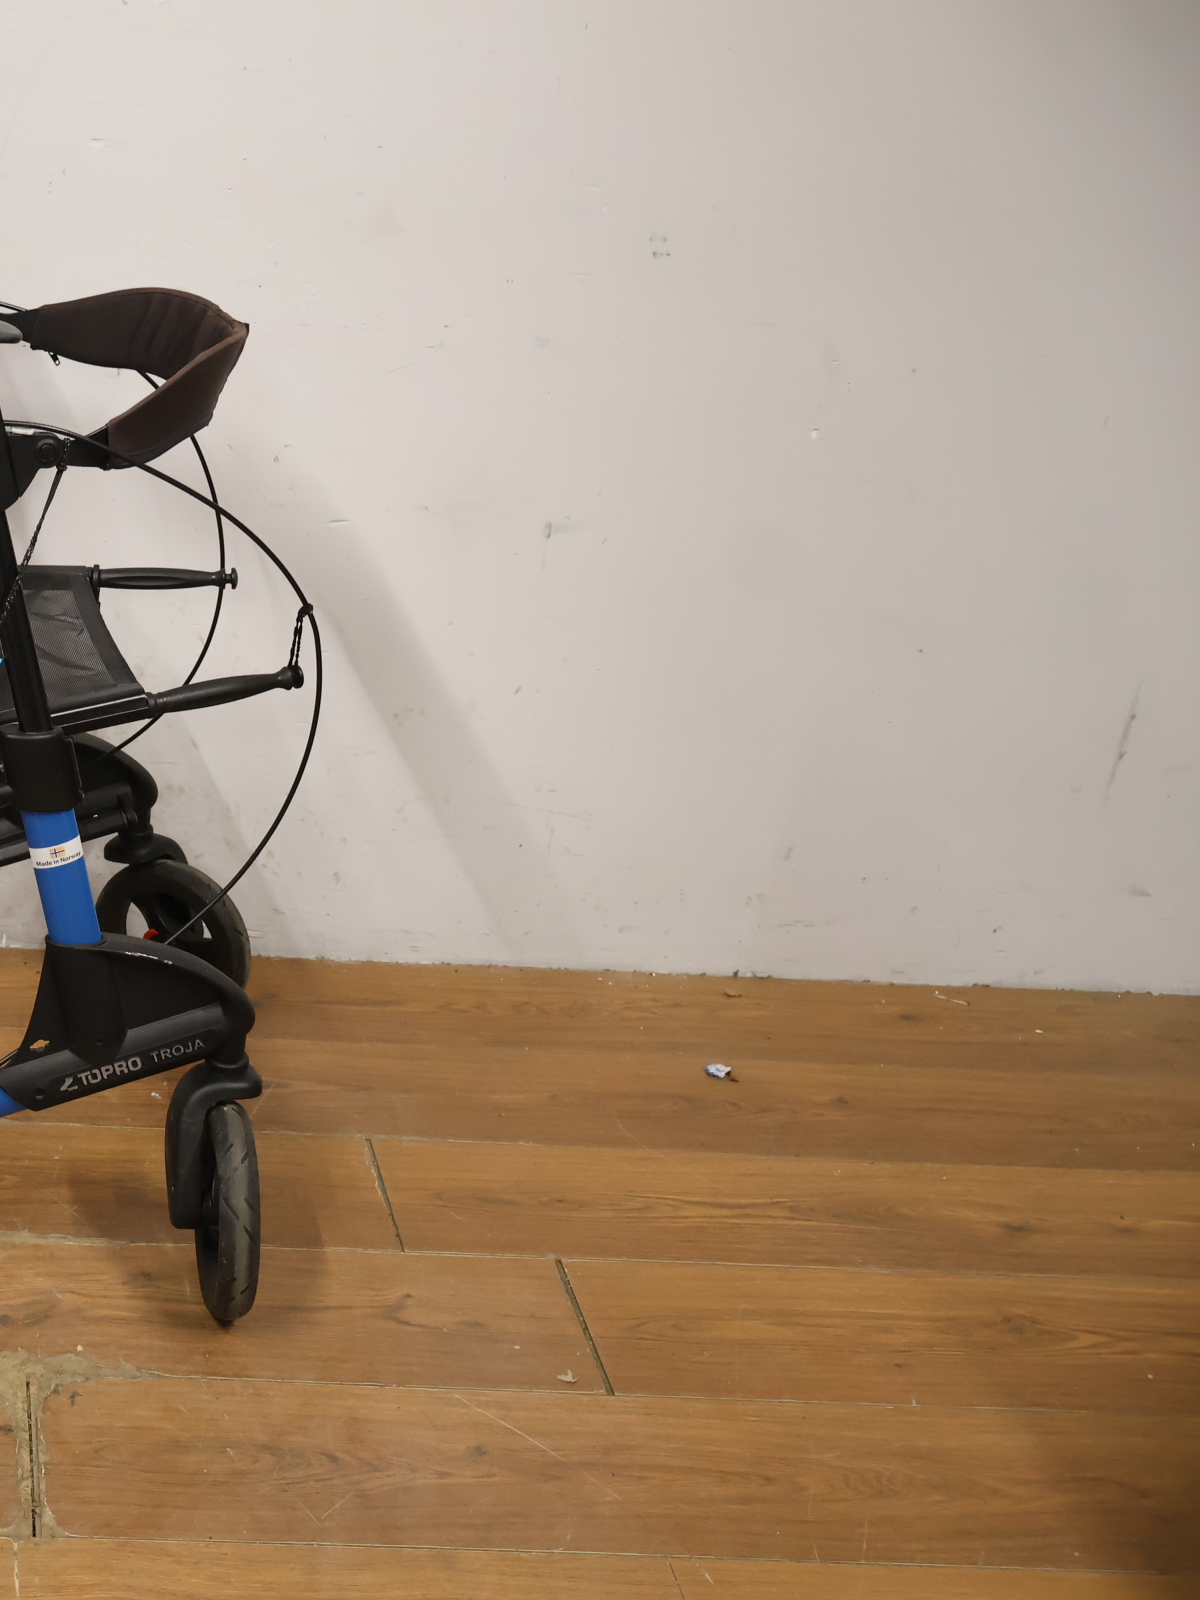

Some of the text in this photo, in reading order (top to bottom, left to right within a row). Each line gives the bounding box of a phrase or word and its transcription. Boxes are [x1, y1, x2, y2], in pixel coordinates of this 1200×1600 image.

[60, 851, 81, 862] Norway
[77, 1039, 205, 1086] TOPRO TROJA
